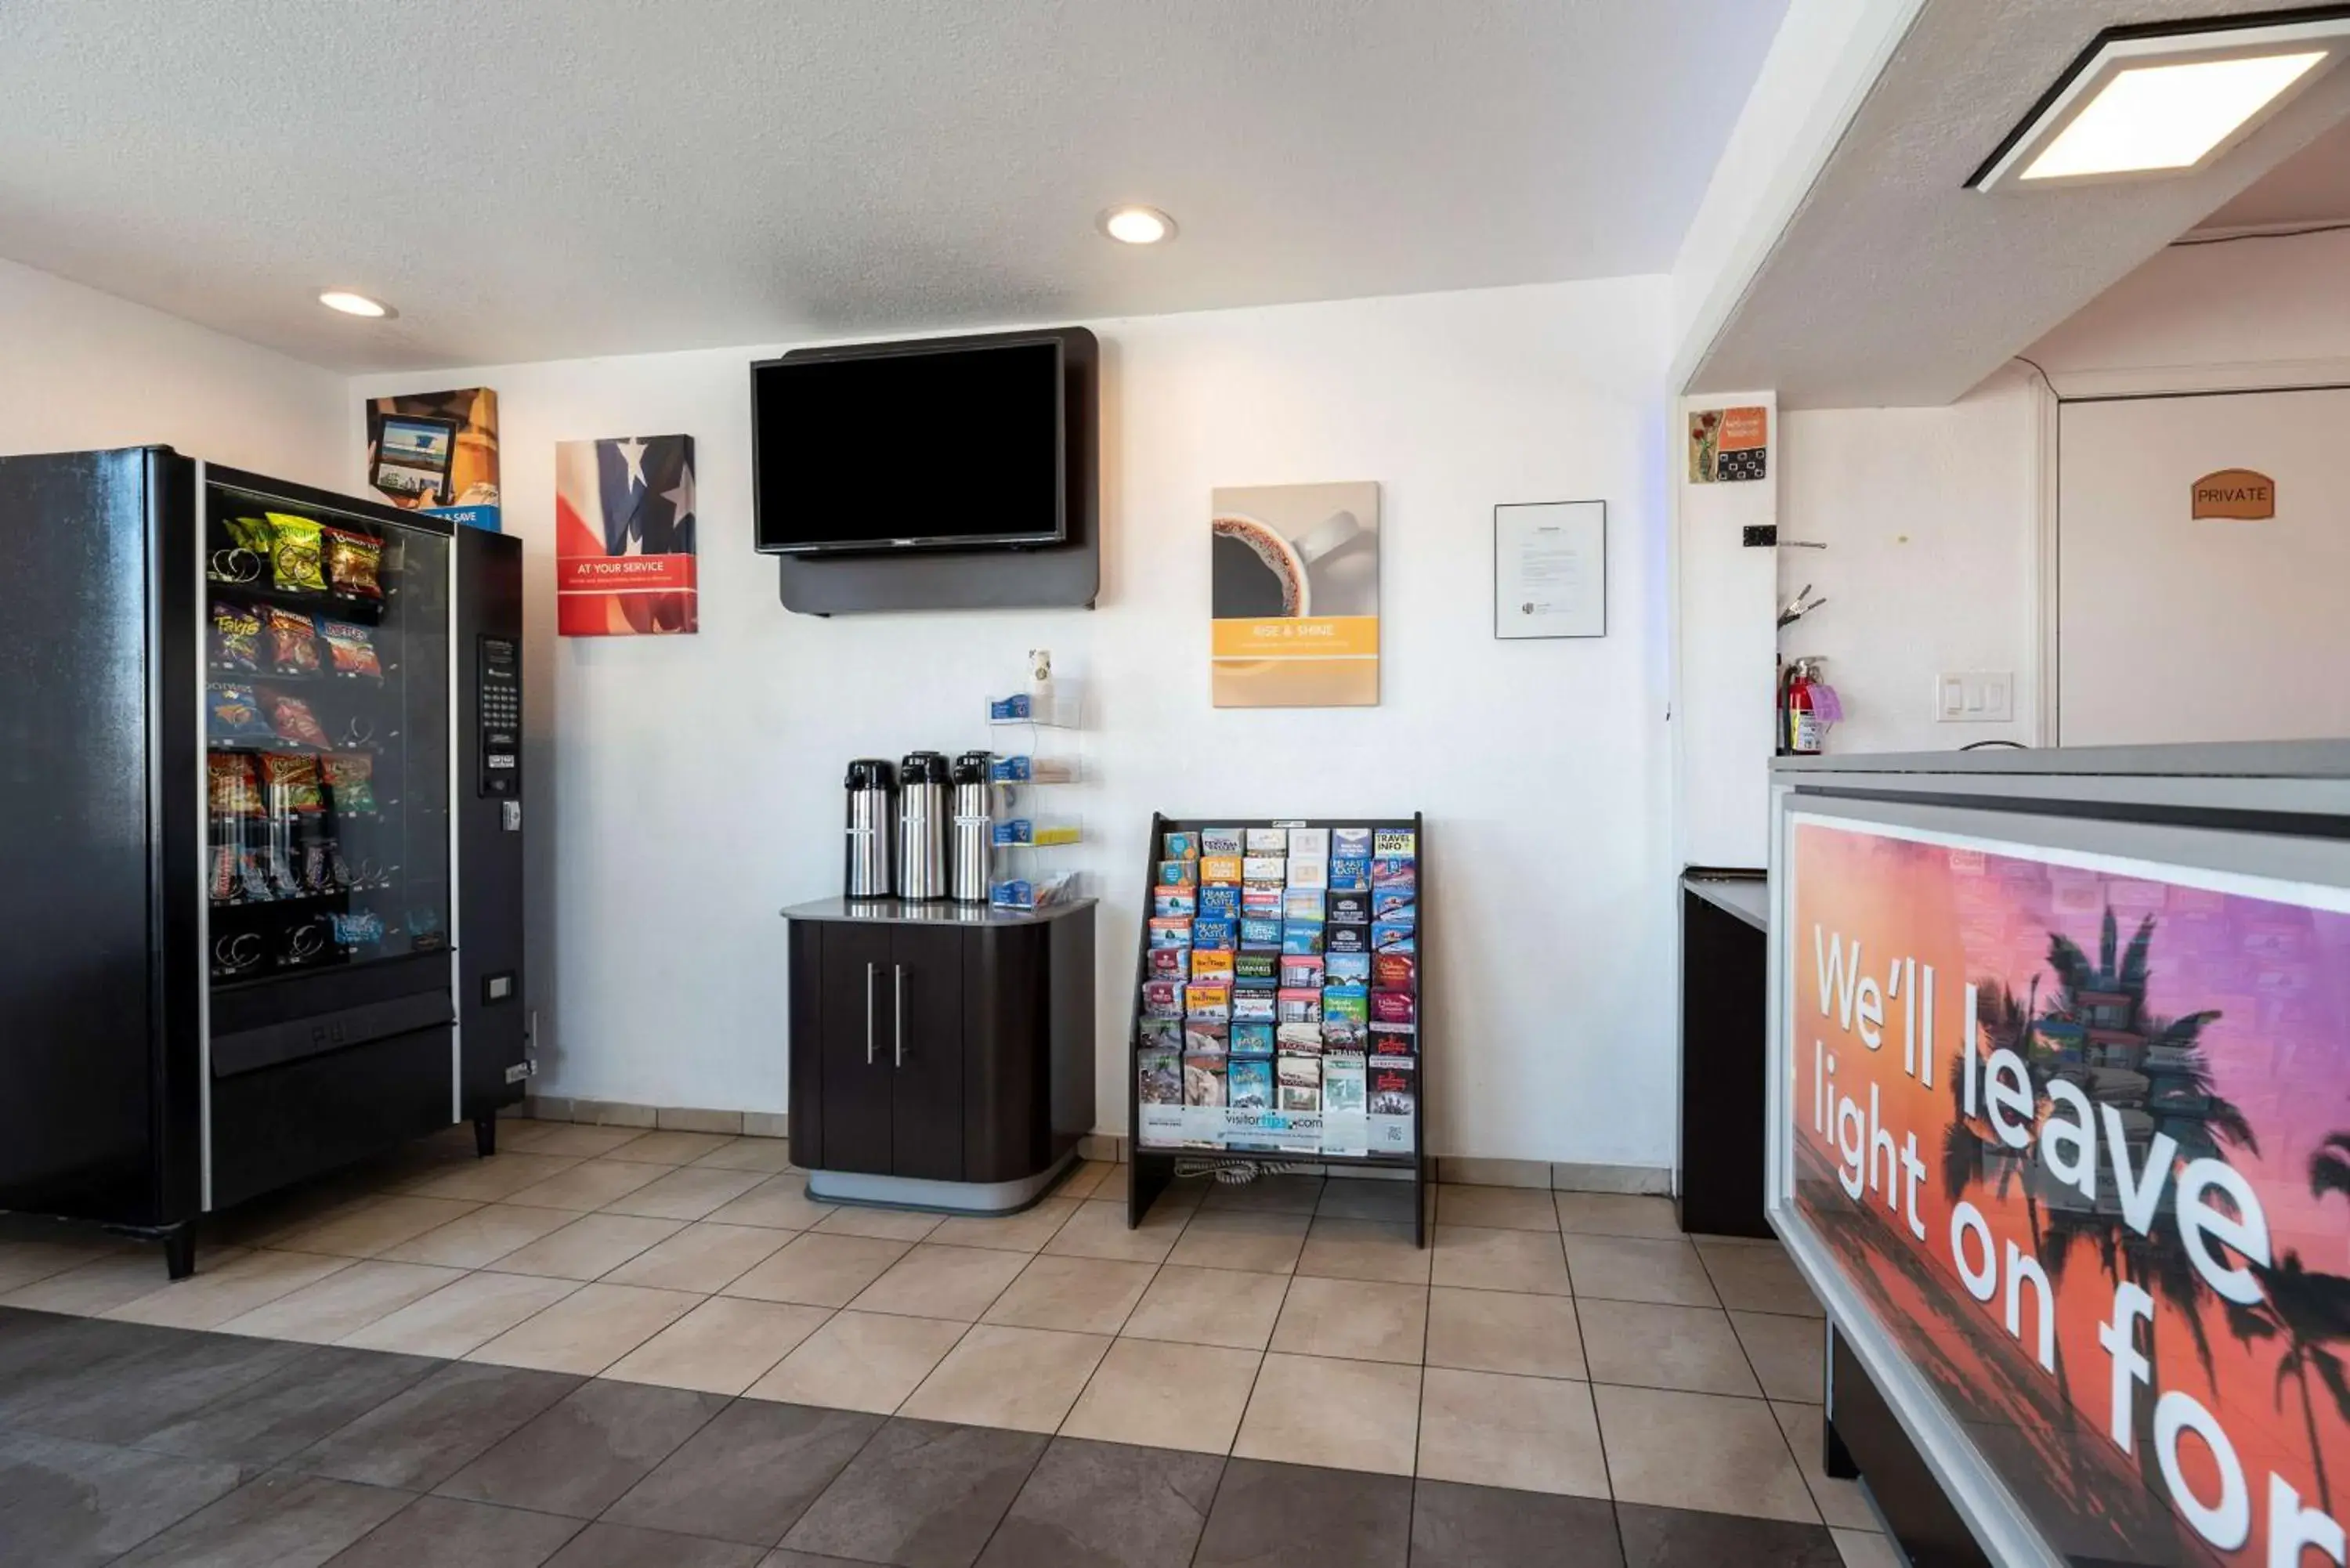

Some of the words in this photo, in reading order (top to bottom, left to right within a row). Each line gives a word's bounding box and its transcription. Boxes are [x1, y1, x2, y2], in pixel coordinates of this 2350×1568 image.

[2198, 487, 2267, 502] PRIVATE
[454, 511, 477, 523] SAVE
[577, 563, 591, 575] AT
[594, 562, 621, 574] YOUR
[623, 561, 664, 573] SERVICE
[1377, 833, 1410, 842] TRAVEL
[1378, 842, 1401, 851] INFO
[1202, 889, 1235, 898] HEARST
[1814, 923, 1935, 1090] We'll
[1964, 981, 2270, 1305] leave
[1815, 1040, 1926, 1242] light
[1950, 1200, 2055, 1375] on
